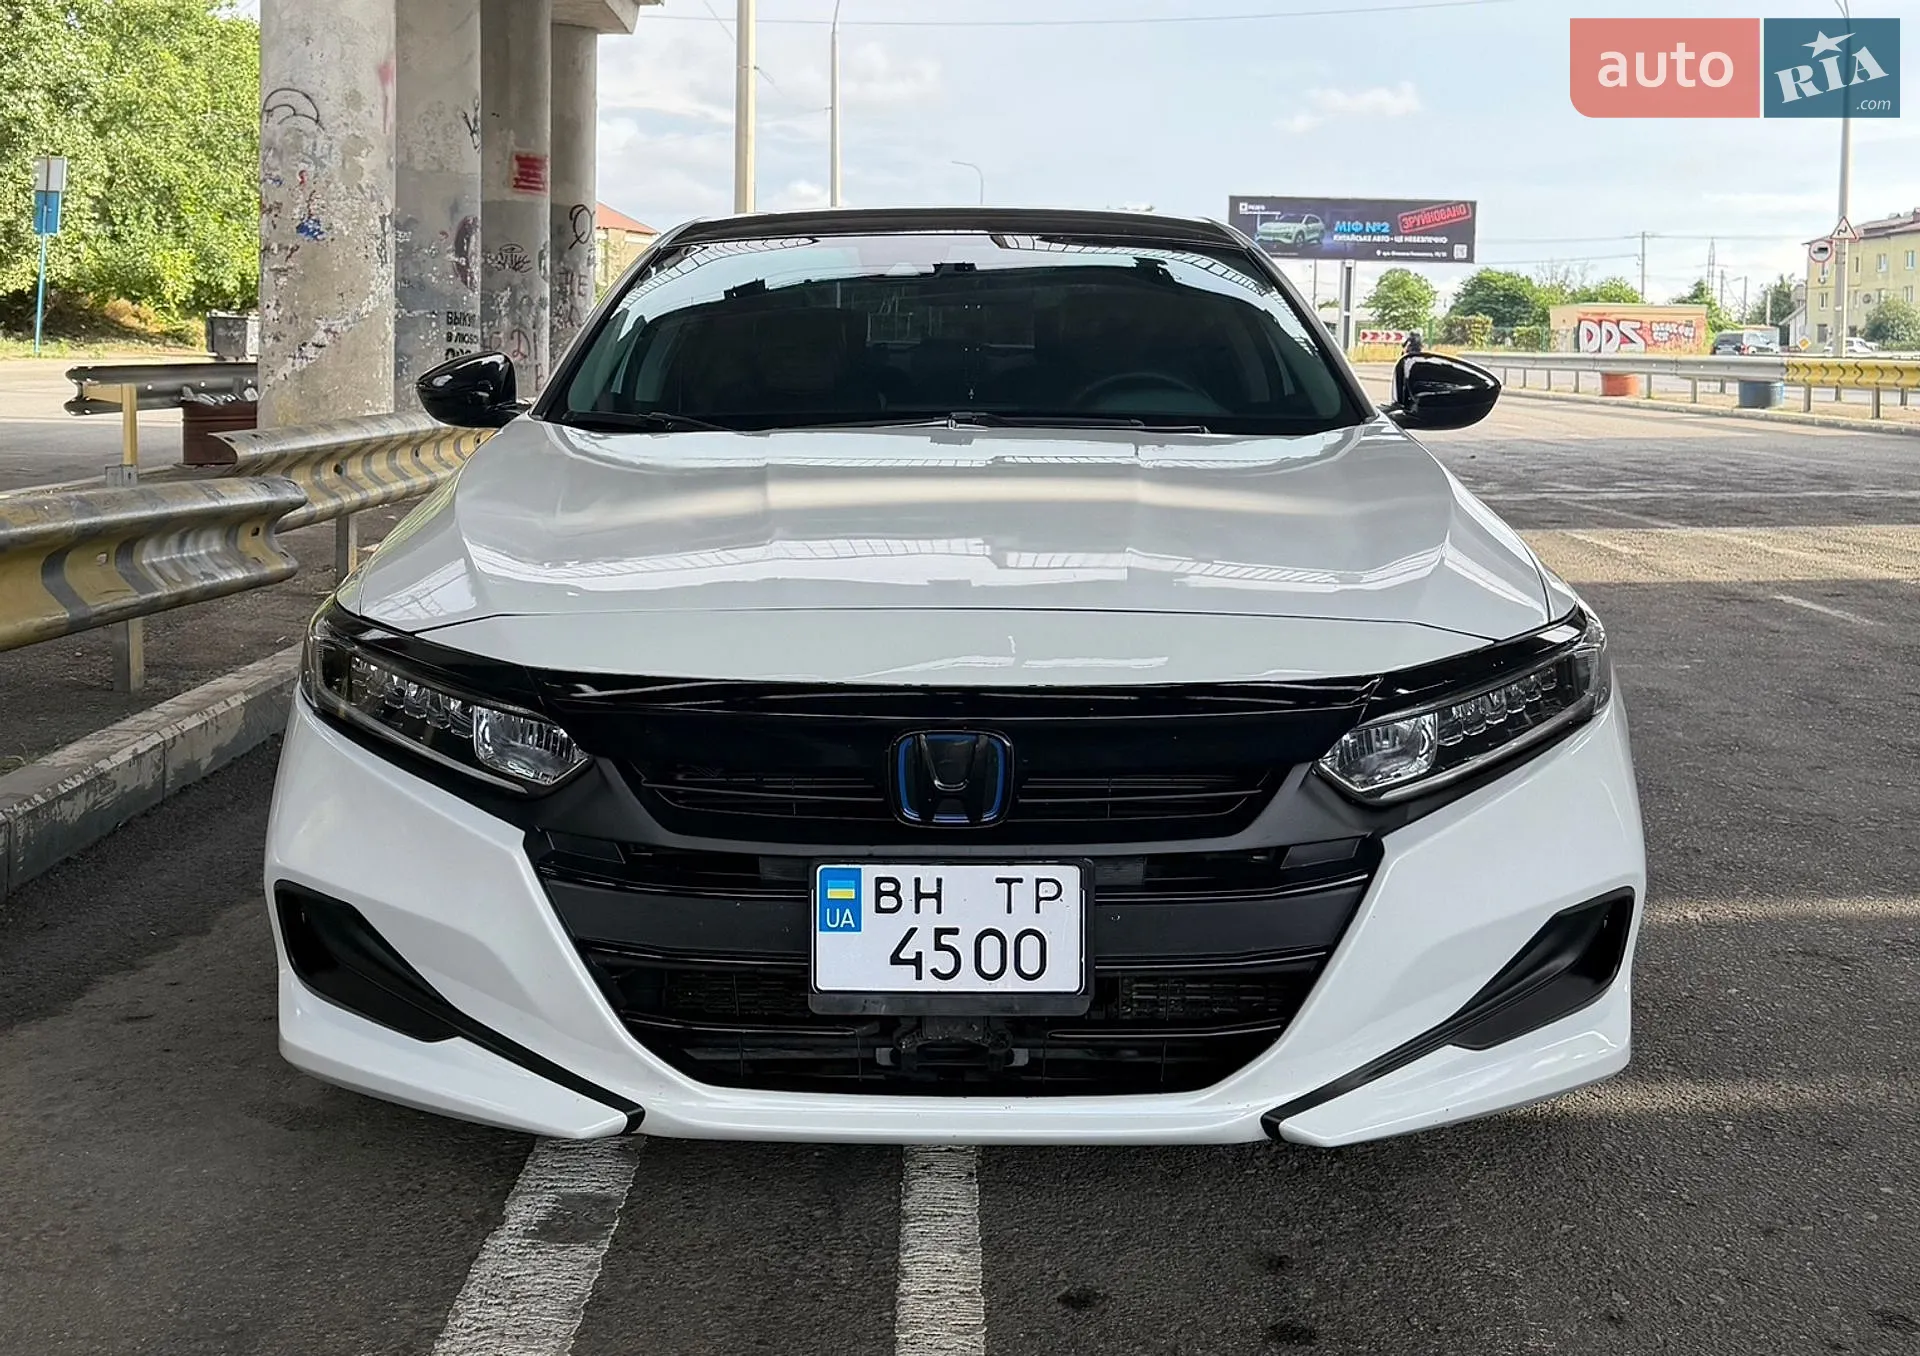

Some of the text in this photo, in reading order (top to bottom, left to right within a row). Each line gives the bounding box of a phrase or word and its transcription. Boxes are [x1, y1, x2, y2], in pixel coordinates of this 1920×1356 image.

[1334, 220, 1390, 233] МІФ №2
[1401, 203, 1466, 229] ЗРУЙНОВАНО
[1372, 234, 1389, 243] АВТО
[874, 876, 1063, 914] BH TP
[826, 908, 855, 928] UA
[889, 927, 1047, 981] 4500
